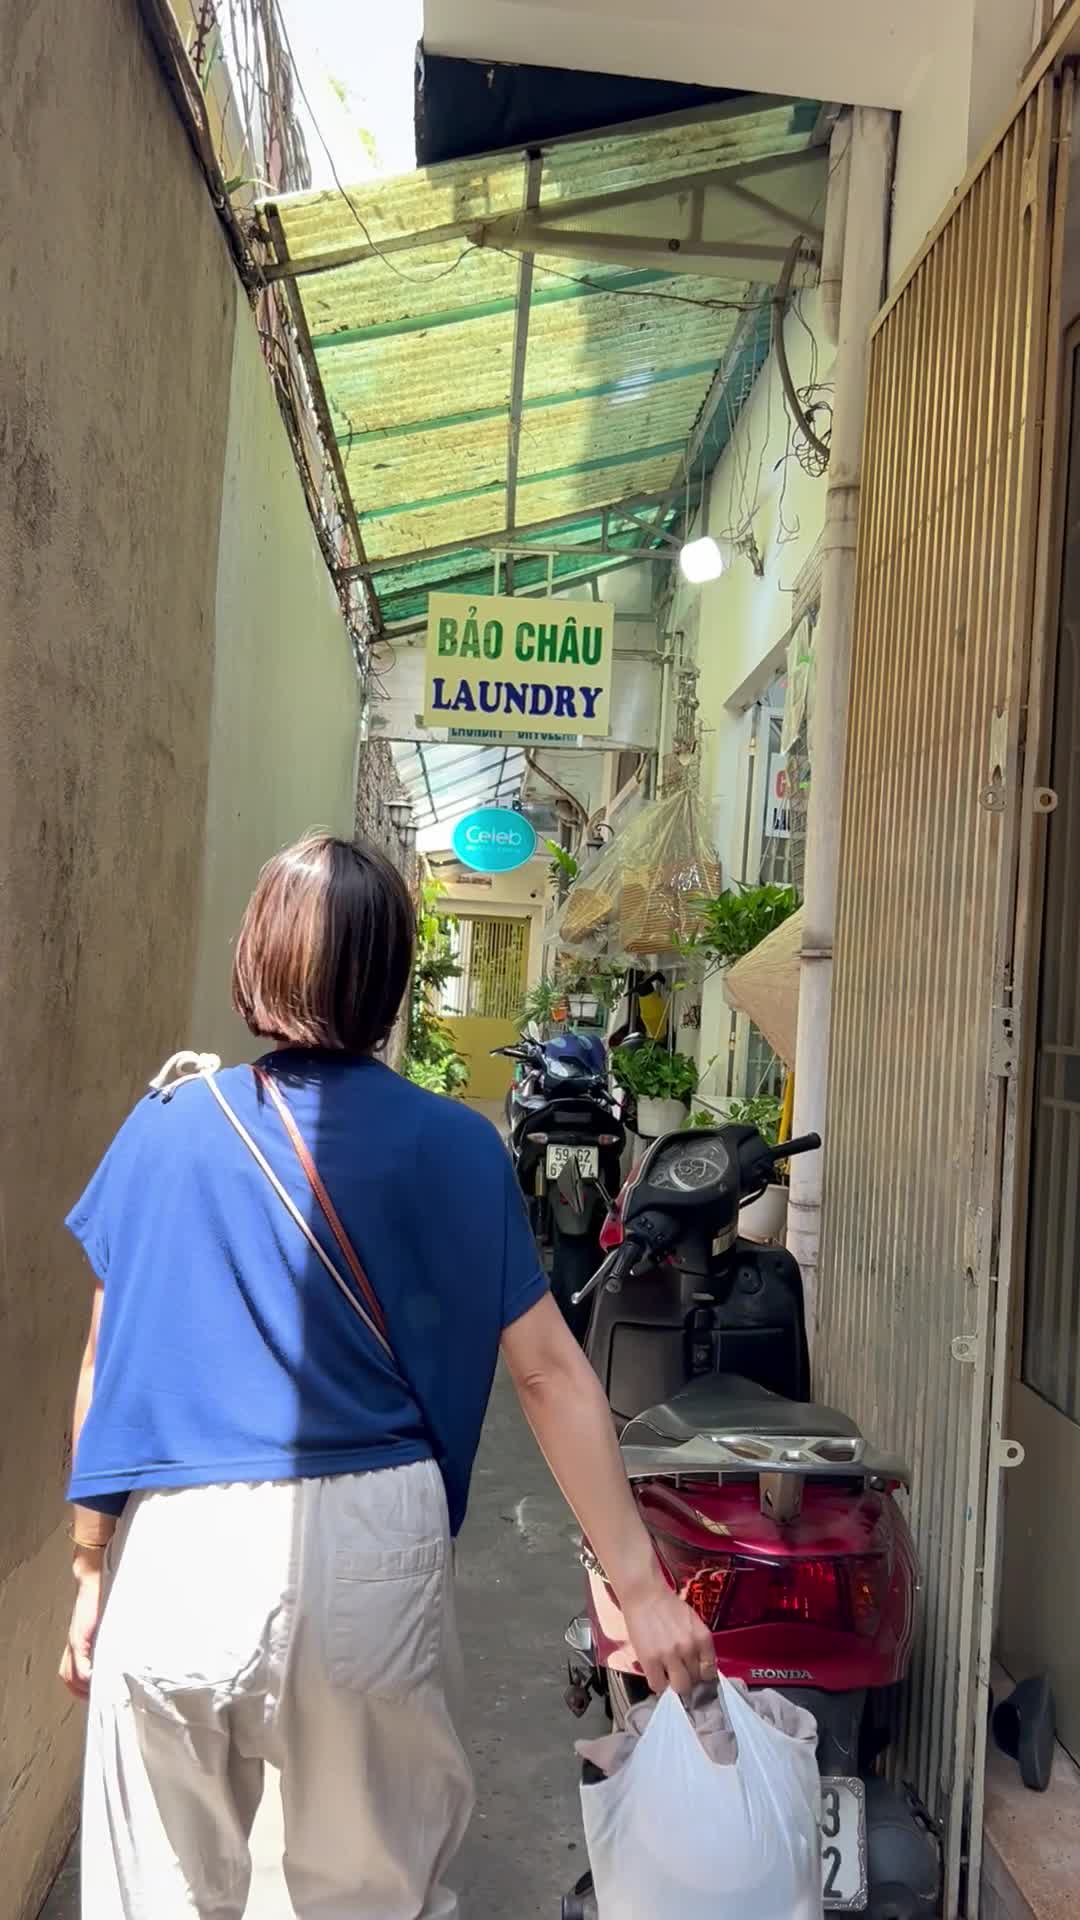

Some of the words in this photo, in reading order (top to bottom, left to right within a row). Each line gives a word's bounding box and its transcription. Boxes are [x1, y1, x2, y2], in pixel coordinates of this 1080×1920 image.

[438, 606, 503, 660] BẢO
[514, 616, 603, 666] CHÂU
[431, 678, 603, 719] LAUNDRY
[465, 825, 522, 846] Celeb
[751, 1668, 814, 1680] HONDA
